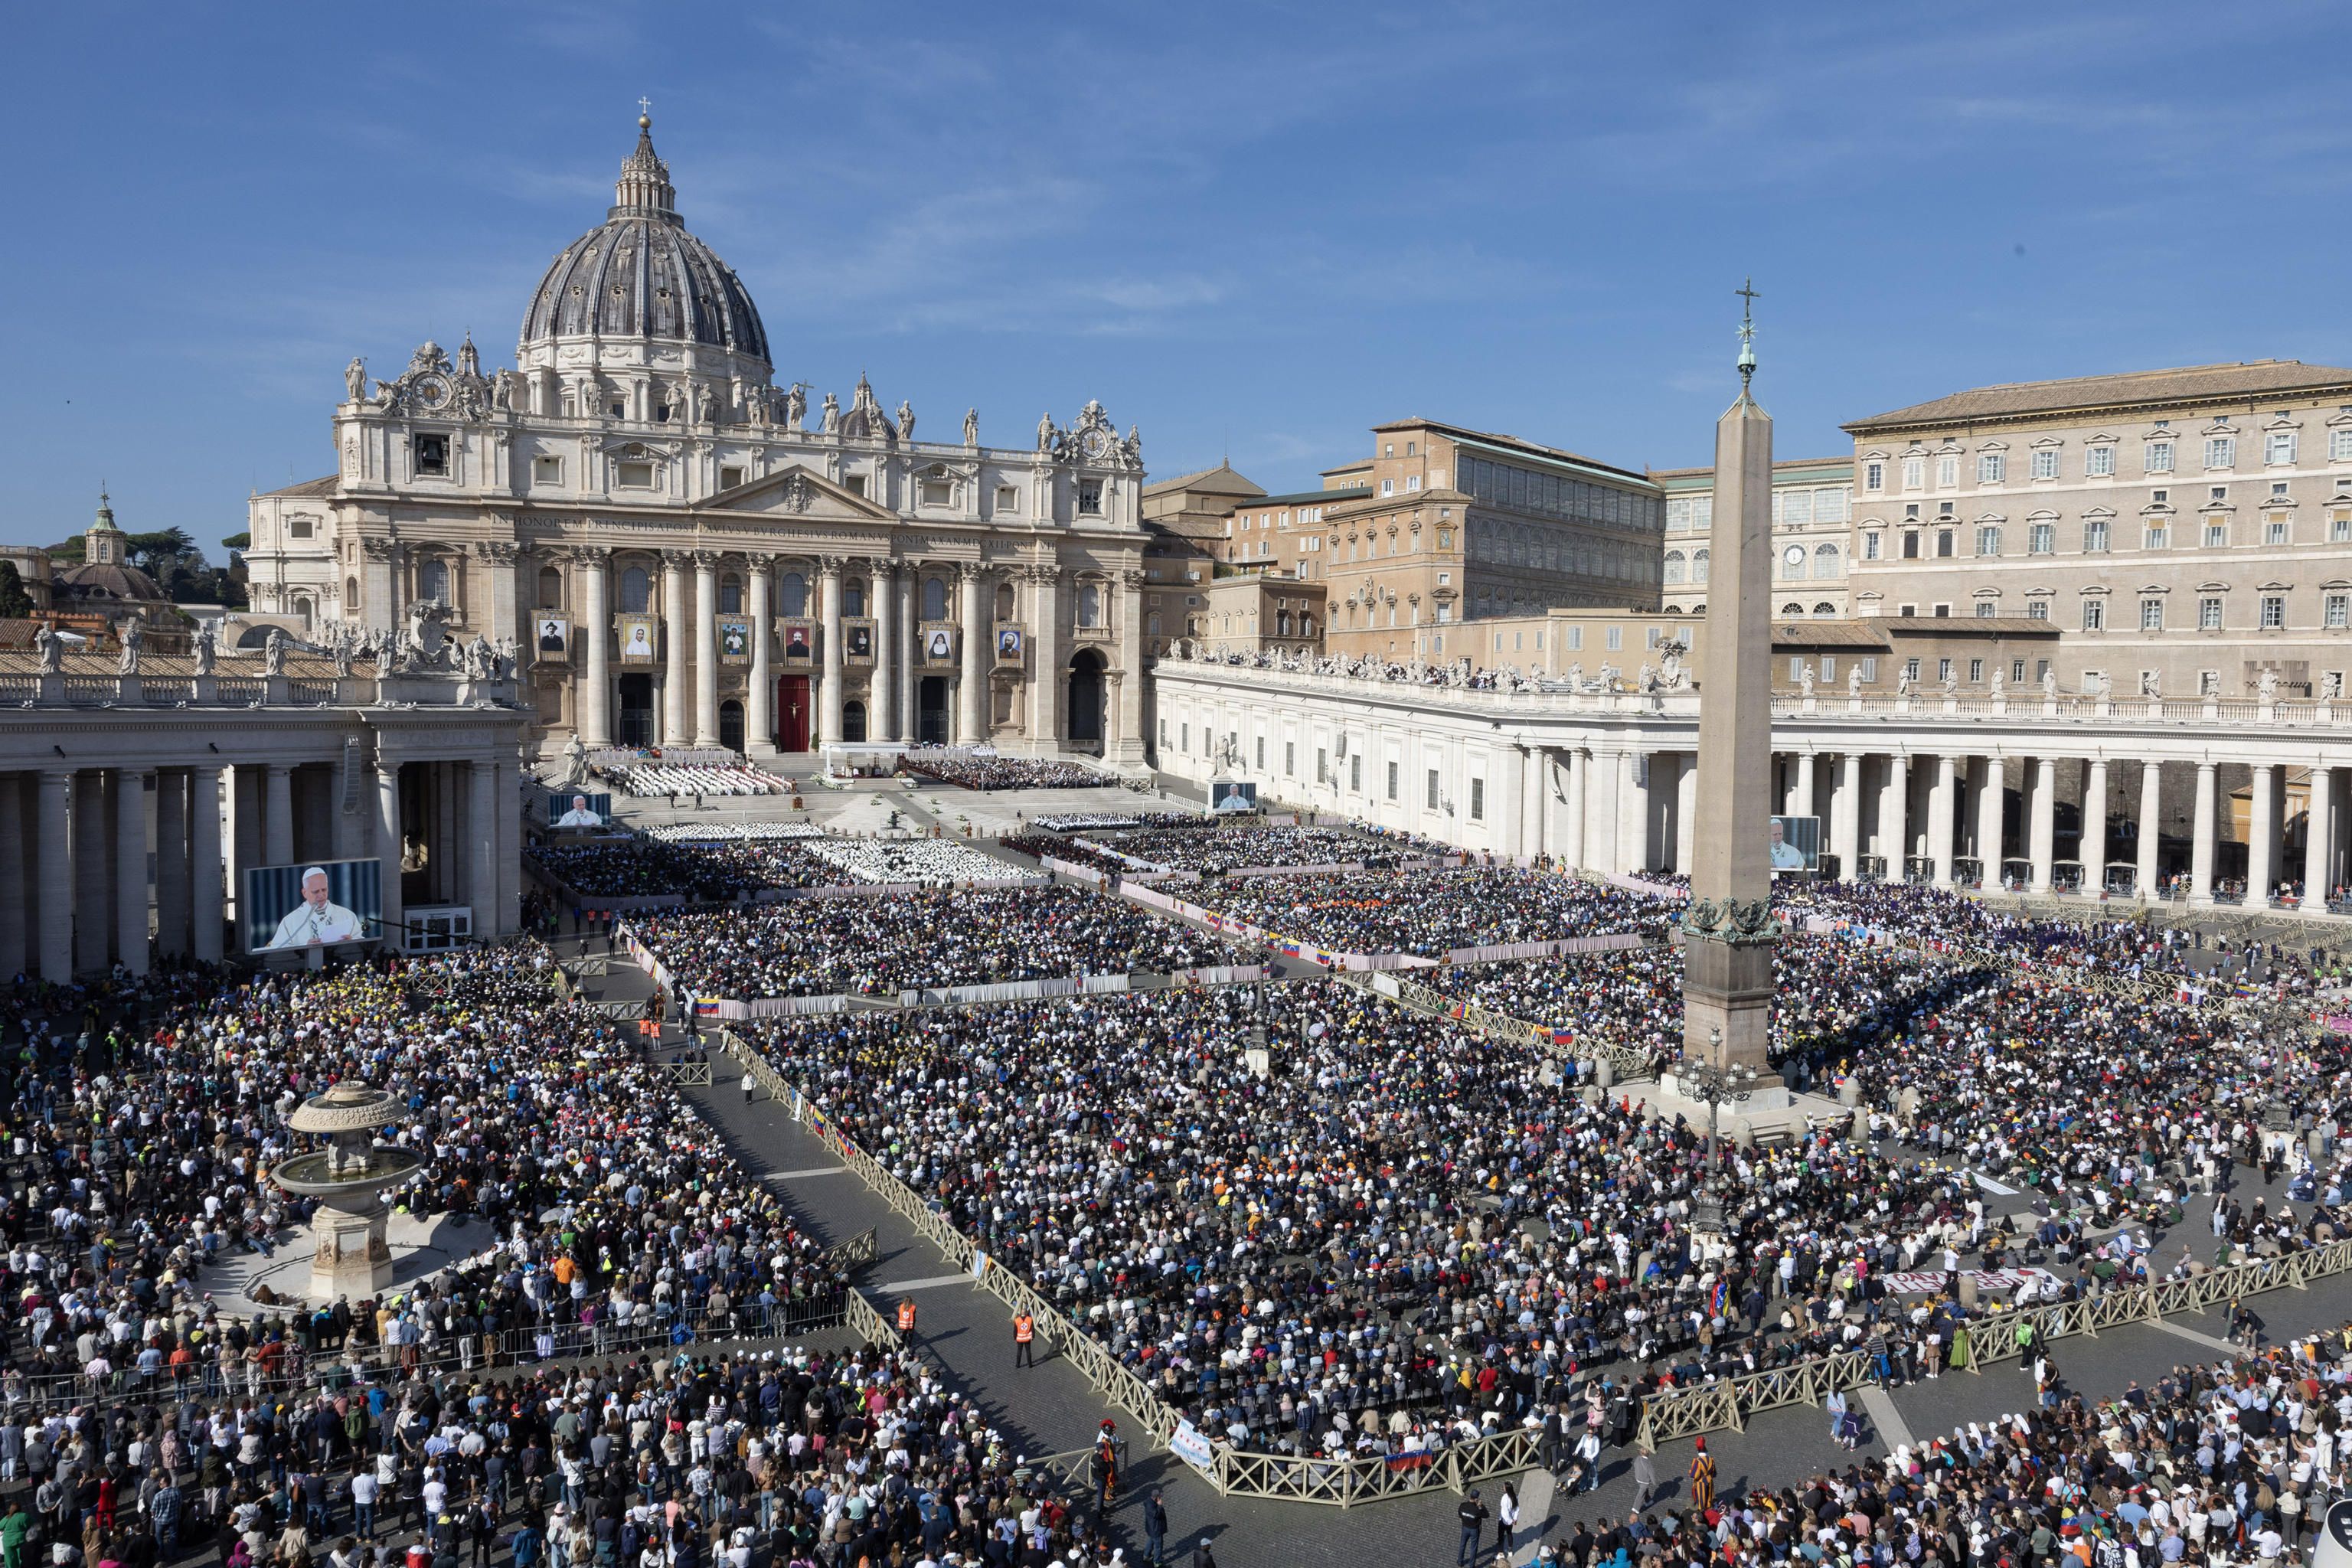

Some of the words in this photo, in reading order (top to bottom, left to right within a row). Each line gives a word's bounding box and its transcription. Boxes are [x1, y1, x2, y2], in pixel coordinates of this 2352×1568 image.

[492, 514, 509, 524] IN
[513, 516, 582, 528] HONOREM
[587, 519, 653, 531] PRINCIPIS
[699, 524, 741, 534] PAVLVS
[753, 526, 828, 539] BVRGHESIVS
[831, 531, 890, 542] ROMANVS
